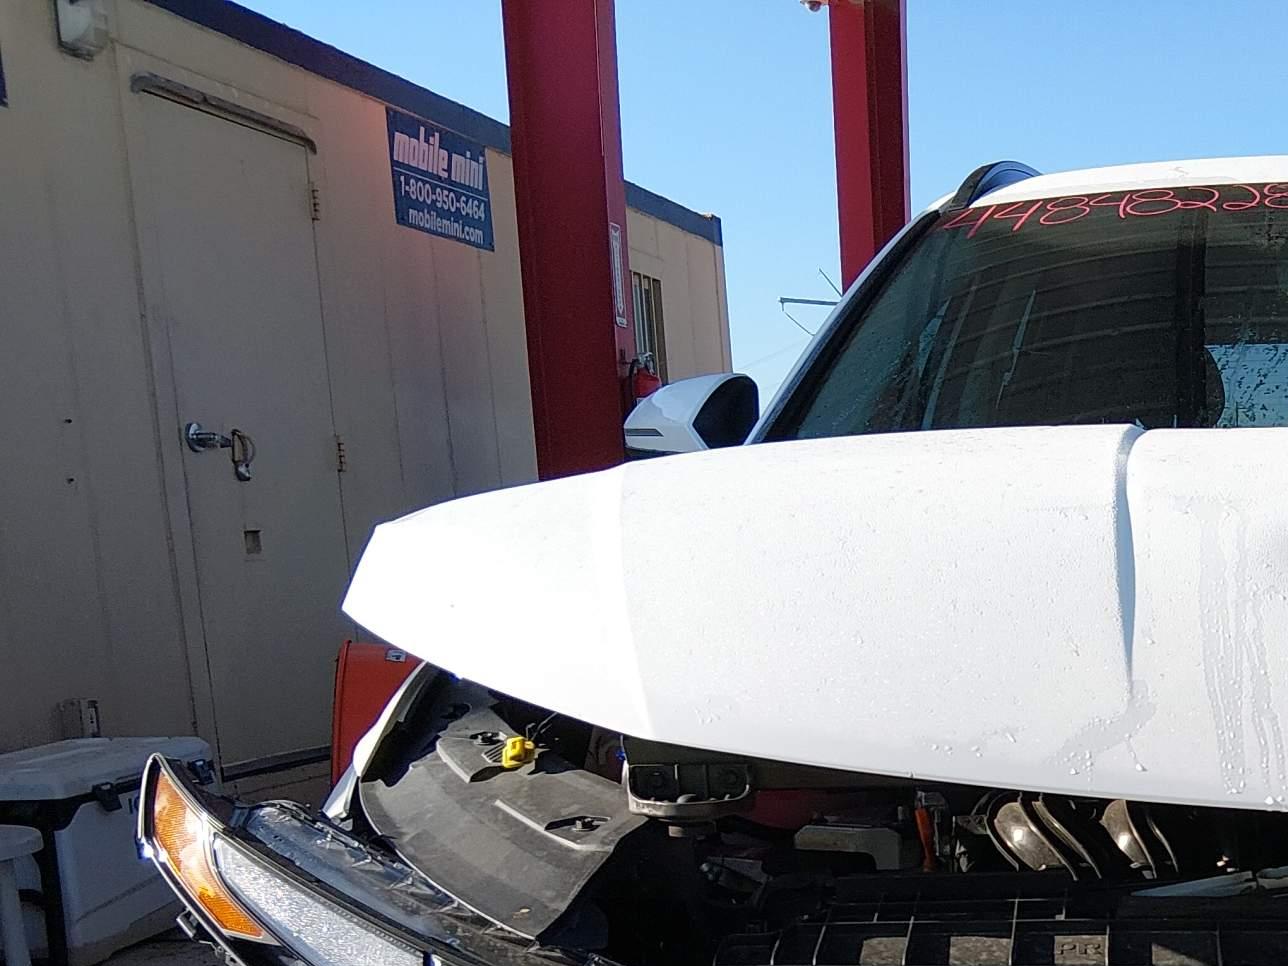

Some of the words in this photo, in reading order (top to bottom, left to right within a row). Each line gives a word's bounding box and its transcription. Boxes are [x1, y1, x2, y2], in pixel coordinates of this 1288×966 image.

[393, 126, 449, 179] mobile
[452, 151, 484, 191] mini
[400, 175, 485, 222] 1-800-950-6464
[408, 208, 484, 245] mobilemini.com
